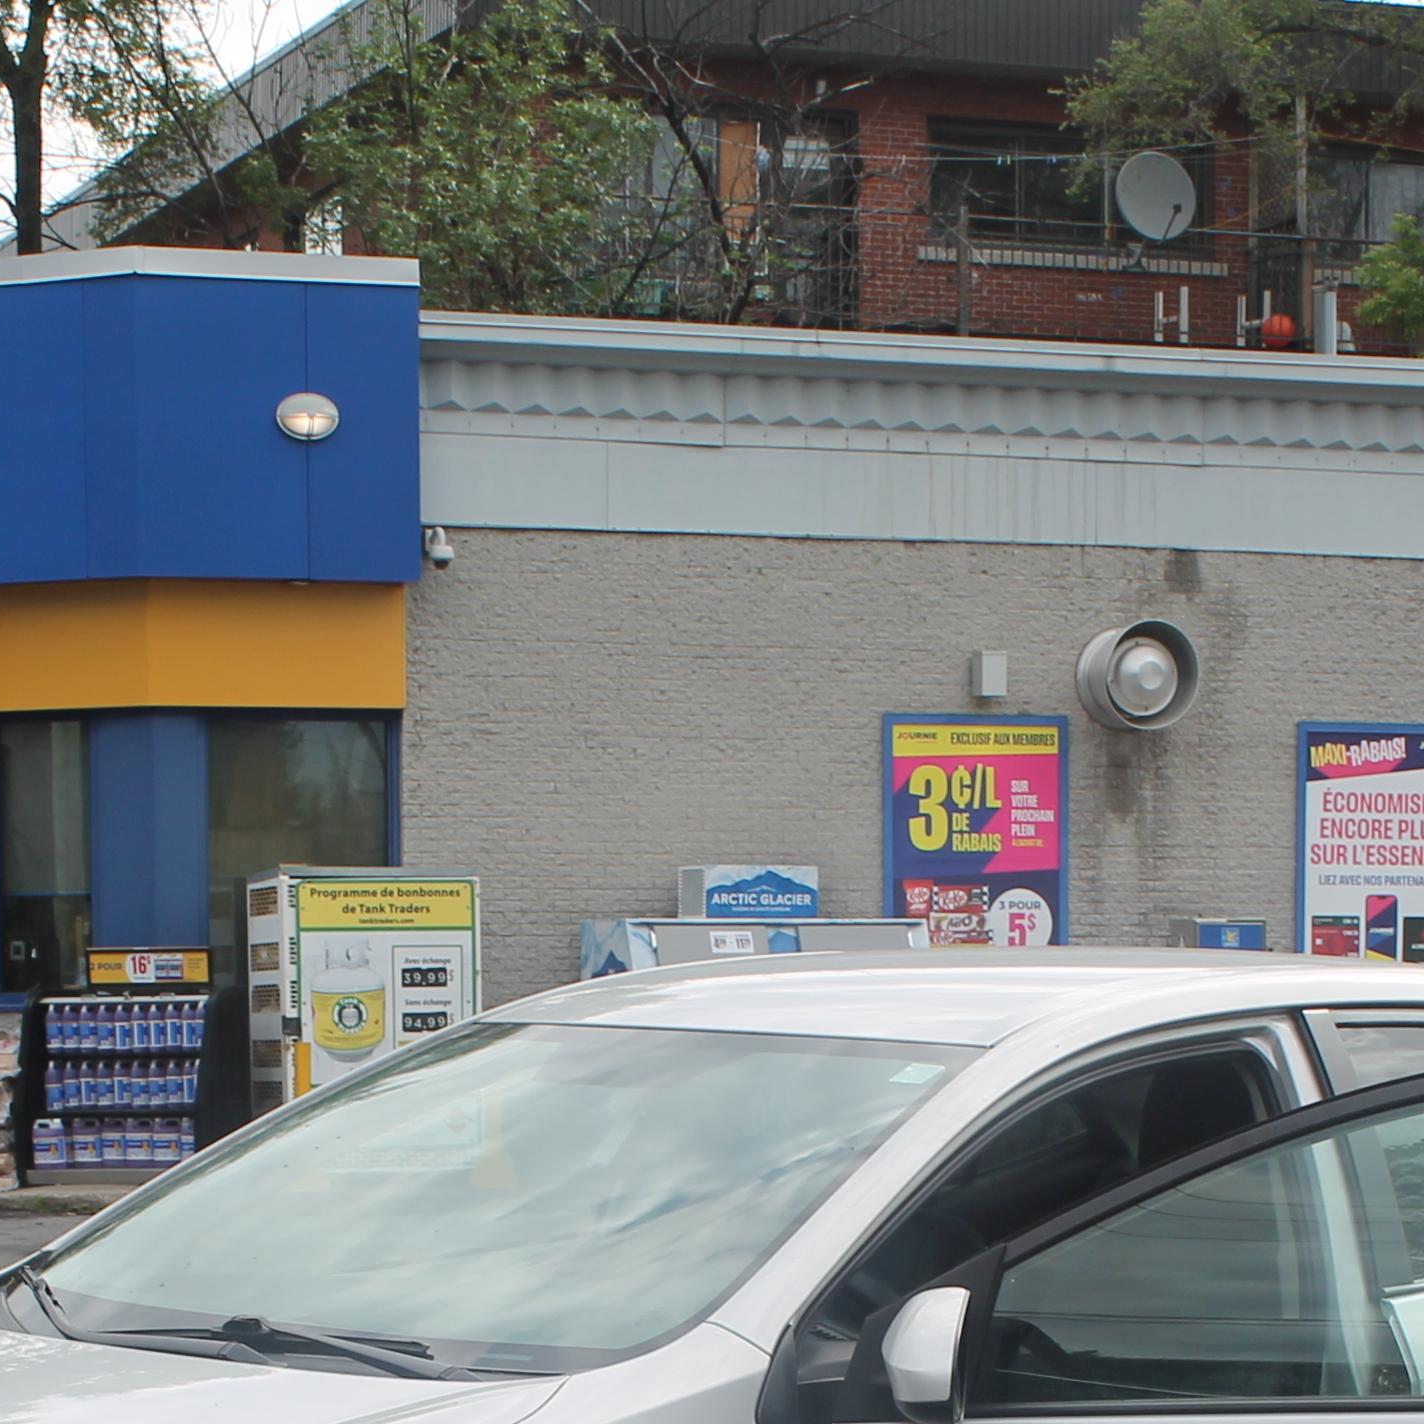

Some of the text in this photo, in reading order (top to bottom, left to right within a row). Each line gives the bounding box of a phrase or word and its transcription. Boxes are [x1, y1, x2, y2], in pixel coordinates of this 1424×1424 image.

[897, 732, 937, 740] JOURNIE
[951, 732, 1055, 746] EXCLUSIF AUX MEMBRES
[1310, 737, 1407, 767] MAXI-RABAIS!
[1011, 780, 1029, 793] SUR
[908, 763, 1002, 852] 3 ¢/L
[1011, 795, 1038, 807] VOTRE
[952, 813, 970, 831] DE
[1011, 810, 1055, 822] PROCHAIN
[1011, 824, 1036, 837] PLEIN
[1319, 818, 1393, 840] ENCORE
[952, 833, 1002, 852] RABAIS
[1310, 844, 1348, 865] SUR
[1318, 874, 1337, 886] LIEZ
[1339, 875, 1362, 886] AVEC
[1363, 875, 1383, 887] NOS
[310, 887, 461, 902] Programme de bonbonnes
[711, 893, 812, 906] ARCTIC GLACIER
[342, 904, 431, 914] de Tank Traders
[999, 901, 1041, 910] 3 POUR
[97, 962, 122, 970] POUR
[422, 956, 452, 965] échange
[403, 971, 446, 985] 39.99
[422, 998, 452, 1007] échange
[404, 1015, 447, 1029] 94.99
